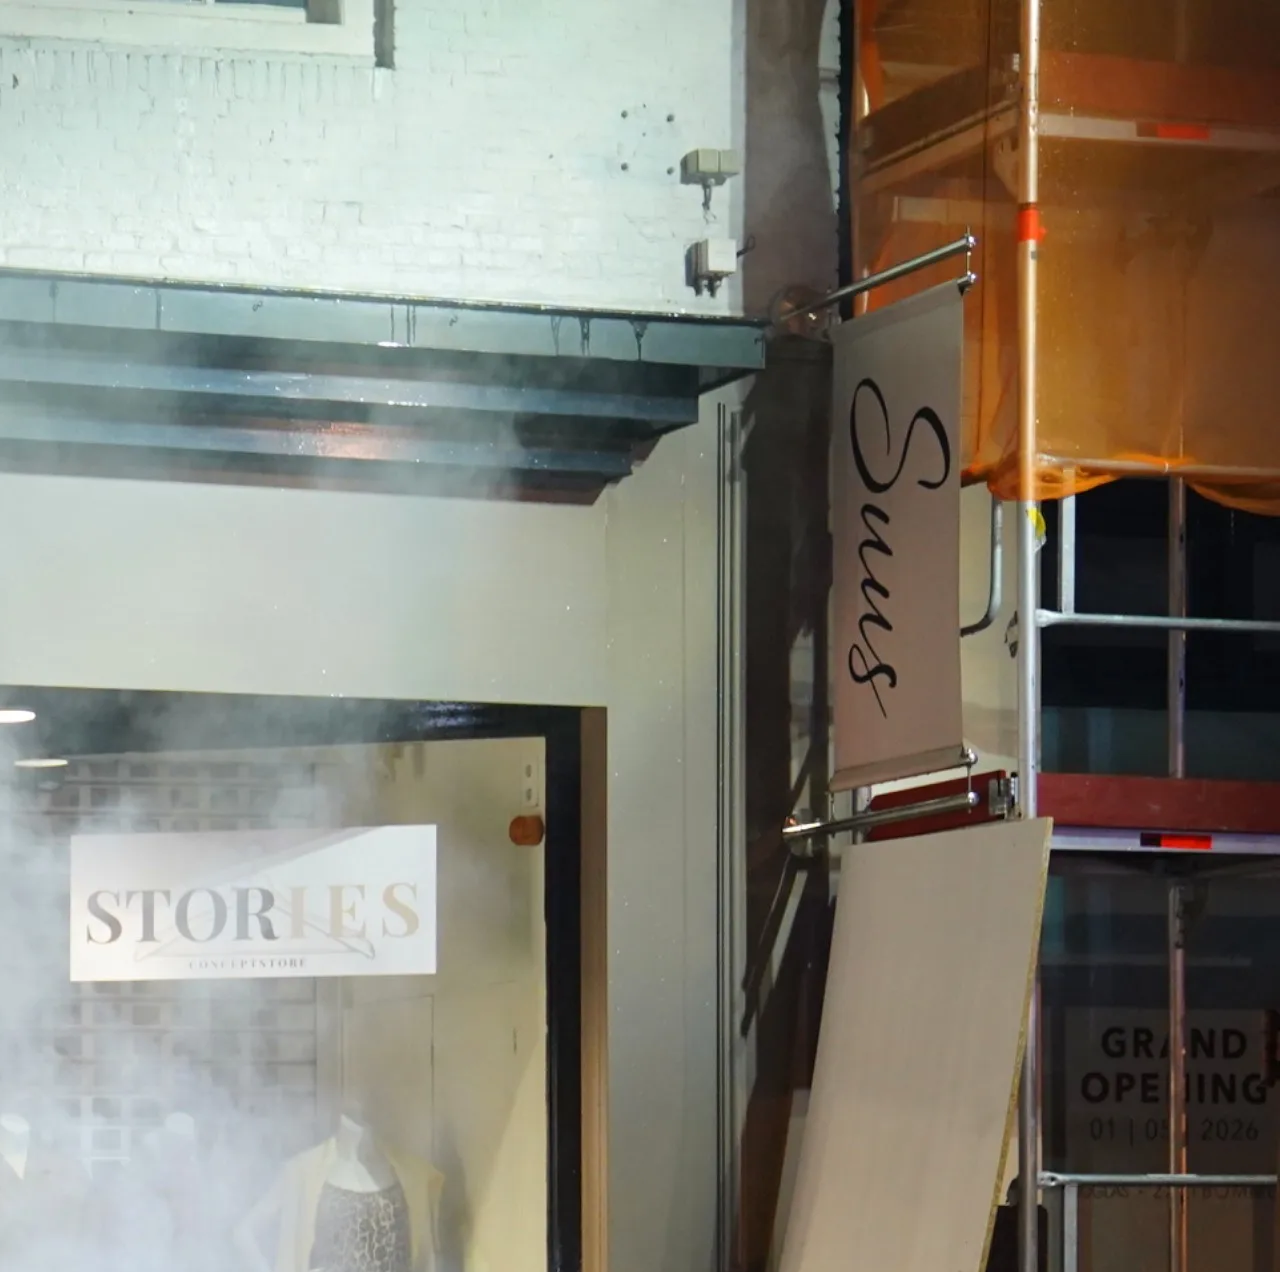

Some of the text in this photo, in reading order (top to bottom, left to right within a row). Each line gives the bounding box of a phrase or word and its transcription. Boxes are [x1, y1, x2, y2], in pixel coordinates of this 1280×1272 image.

[848, 377, 951, 718] Suus
[86, 882, 422, 945] STORIES
[1201, 1118, 1260, 1142] 2026
